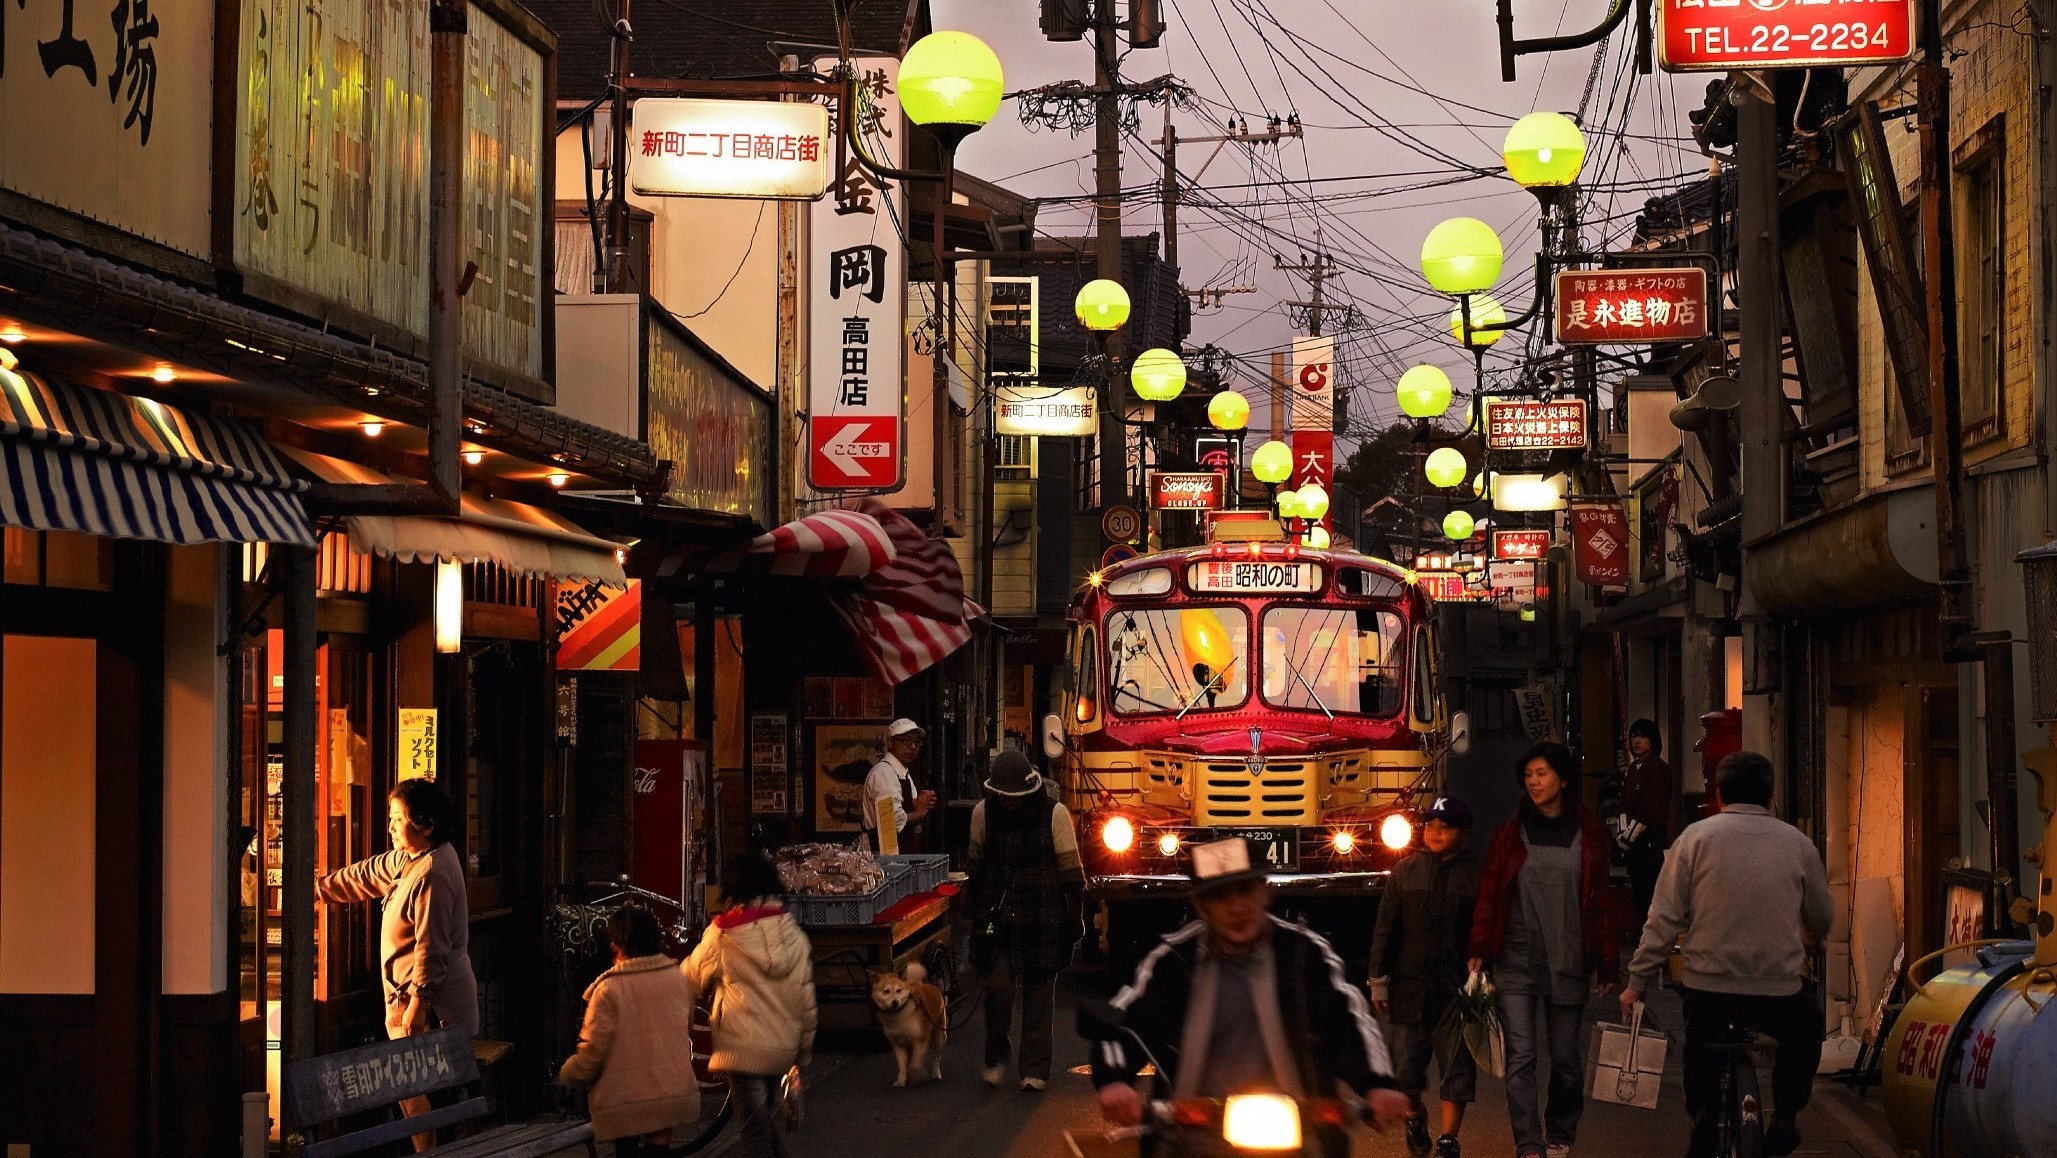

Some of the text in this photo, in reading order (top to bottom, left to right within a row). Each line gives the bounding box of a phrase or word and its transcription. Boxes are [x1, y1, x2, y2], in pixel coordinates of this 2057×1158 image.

[1684, 21, 1889, 54] TEL.22-2234
[641, 129, 820, 163] 新町二丁目商店街
[1566, 296, 1698, 330] 是永進物店
[839, 315, 870, 407] 高田店
[1000, 403, 1093, 418] 新町二丁目商店街
[834, 442, 883, 457] ここです
[1160, 476, 1214, 500] Sonoya
[1112, 516, 1132, 532] 30
[1207, 561, 1234, 575] 豊後
[1235, 563, 1301, 588] 昭和の町
[1207, 575, 1233, 588] 高田
[557, 684, 571, 737] 六号館
[411, 738, 422, 769] ソフト
[1432, 797, 1449, 811] K
[1265, 841, 1289, 864] 41
[341, 1043, 451, 1101] 雪印アイスクリーム
